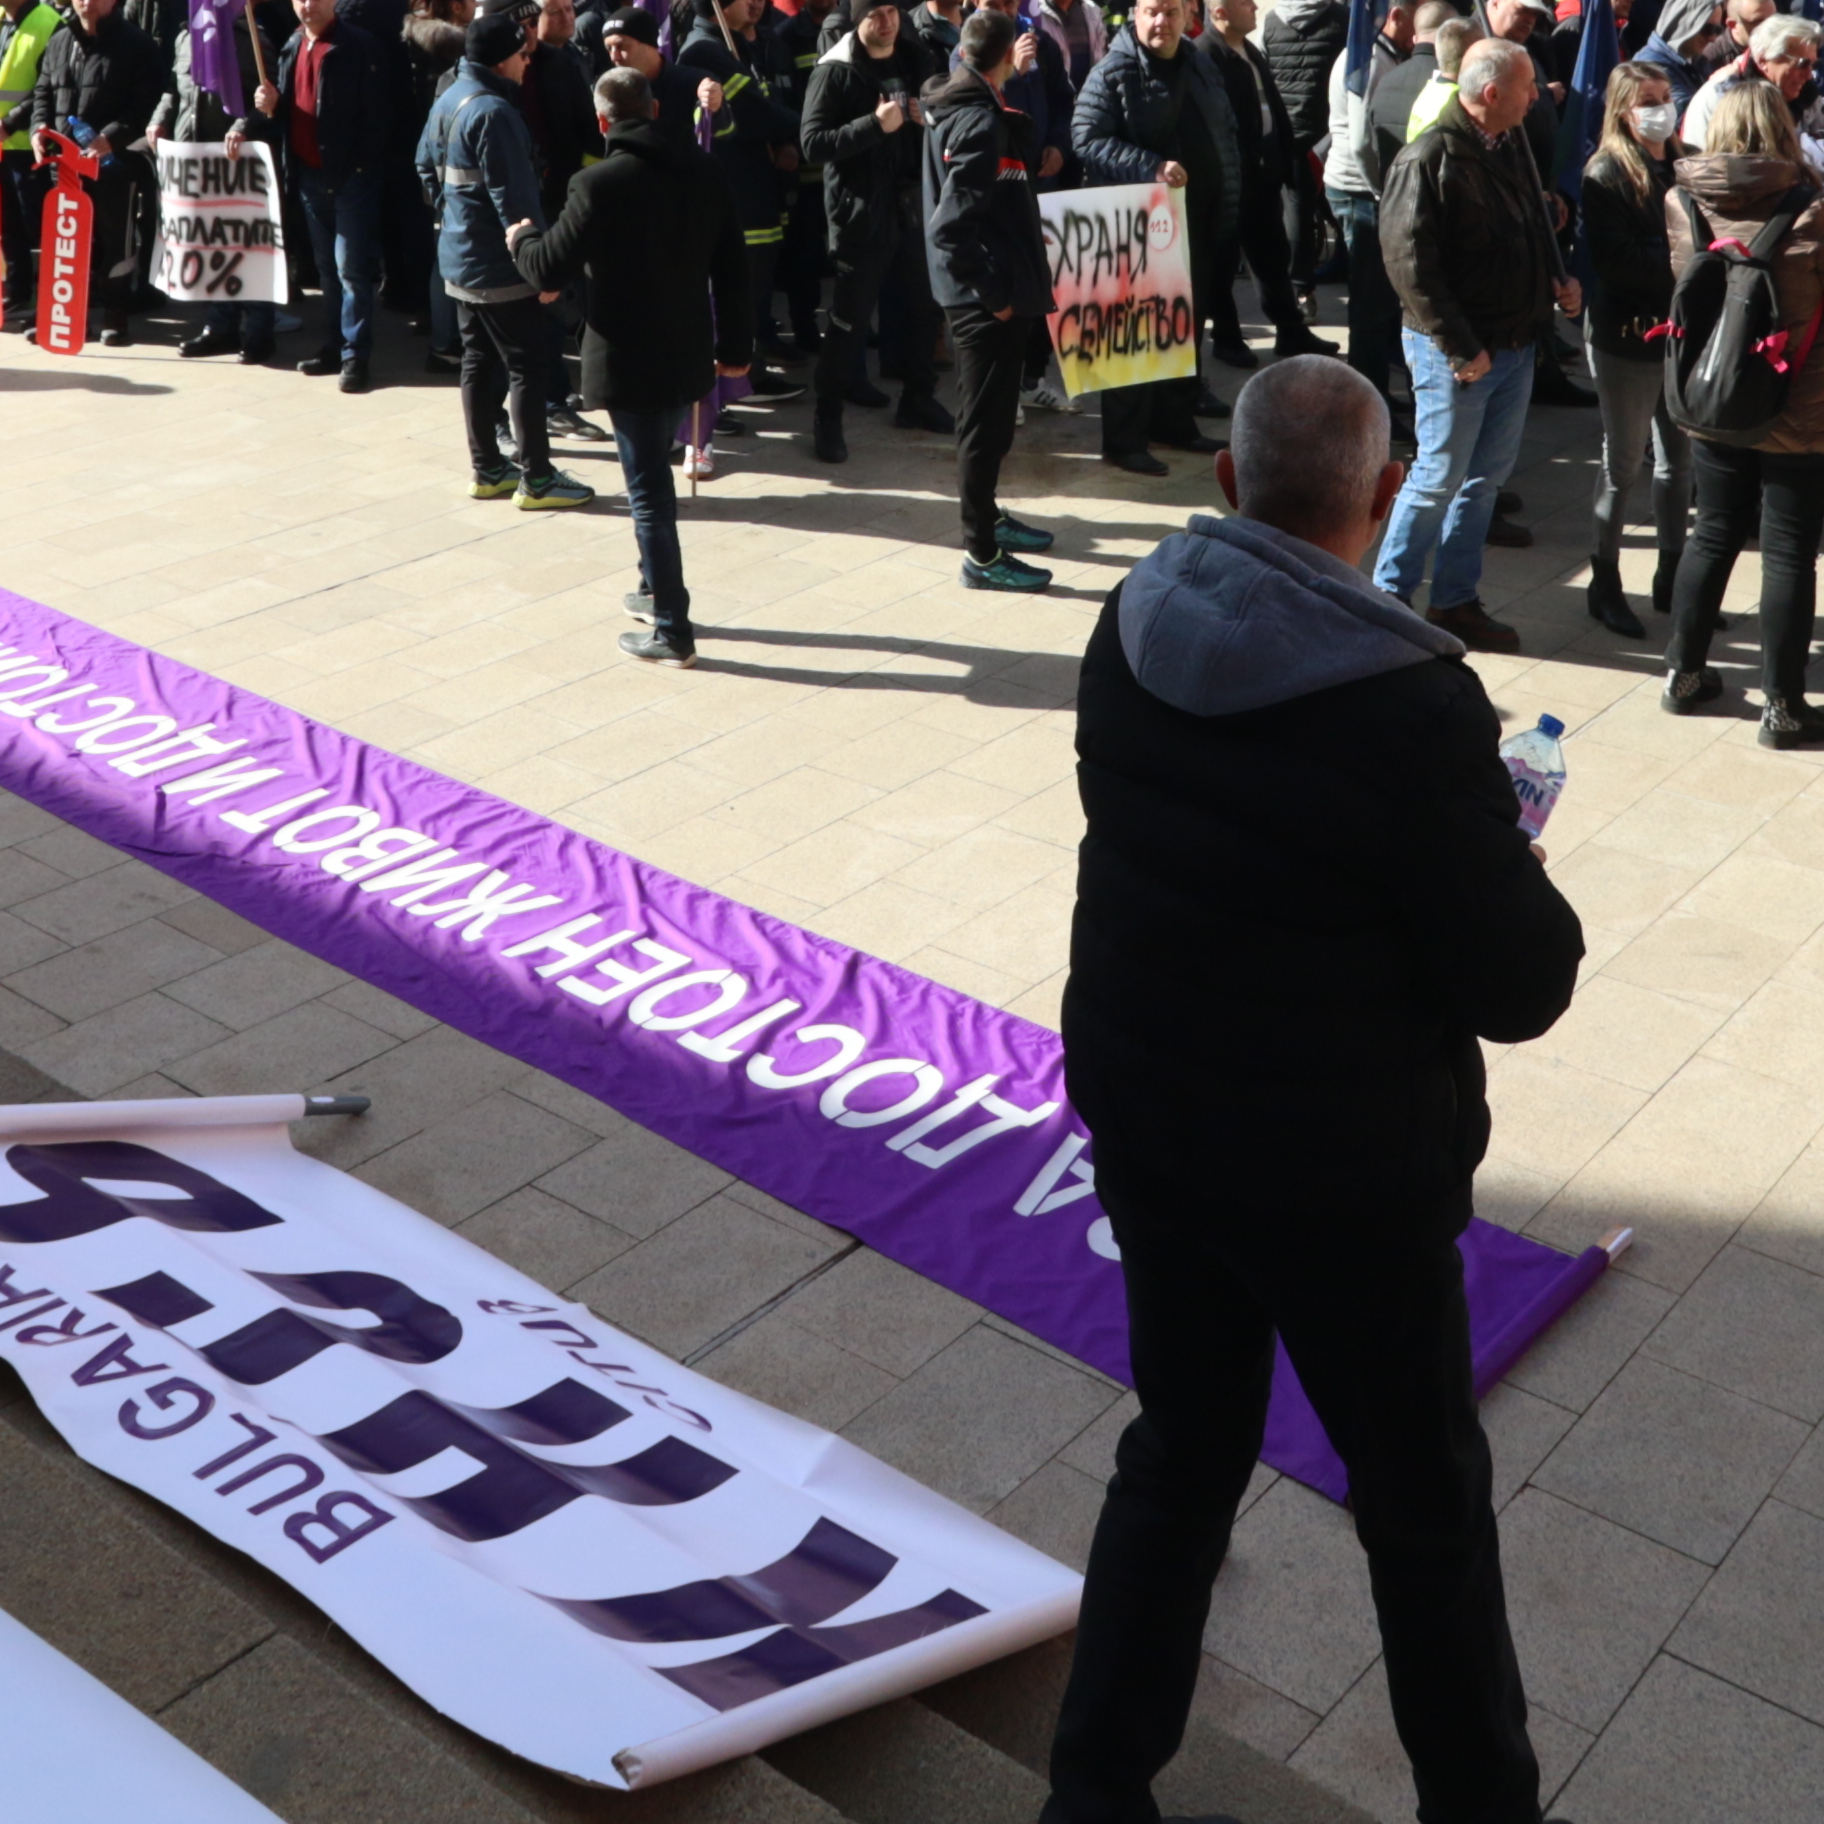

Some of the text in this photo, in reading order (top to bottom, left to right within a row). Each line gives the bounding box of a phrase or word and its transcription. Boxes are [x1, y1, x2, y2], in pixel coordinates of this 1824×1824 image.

[49, 192, 79, 349] ПРОТЕСТ
[1149, 219, 1169, 234] 112
[1058, 293, 1190, 366] СЕМЕЙСТВО
[161, 756, 285, 806] И
[219, 787, 563, 942] ЖИВОТ
[501, 913, 1060, 1170] ДОСТОЕН
[475, 1297, 713, 1435] CITUB
